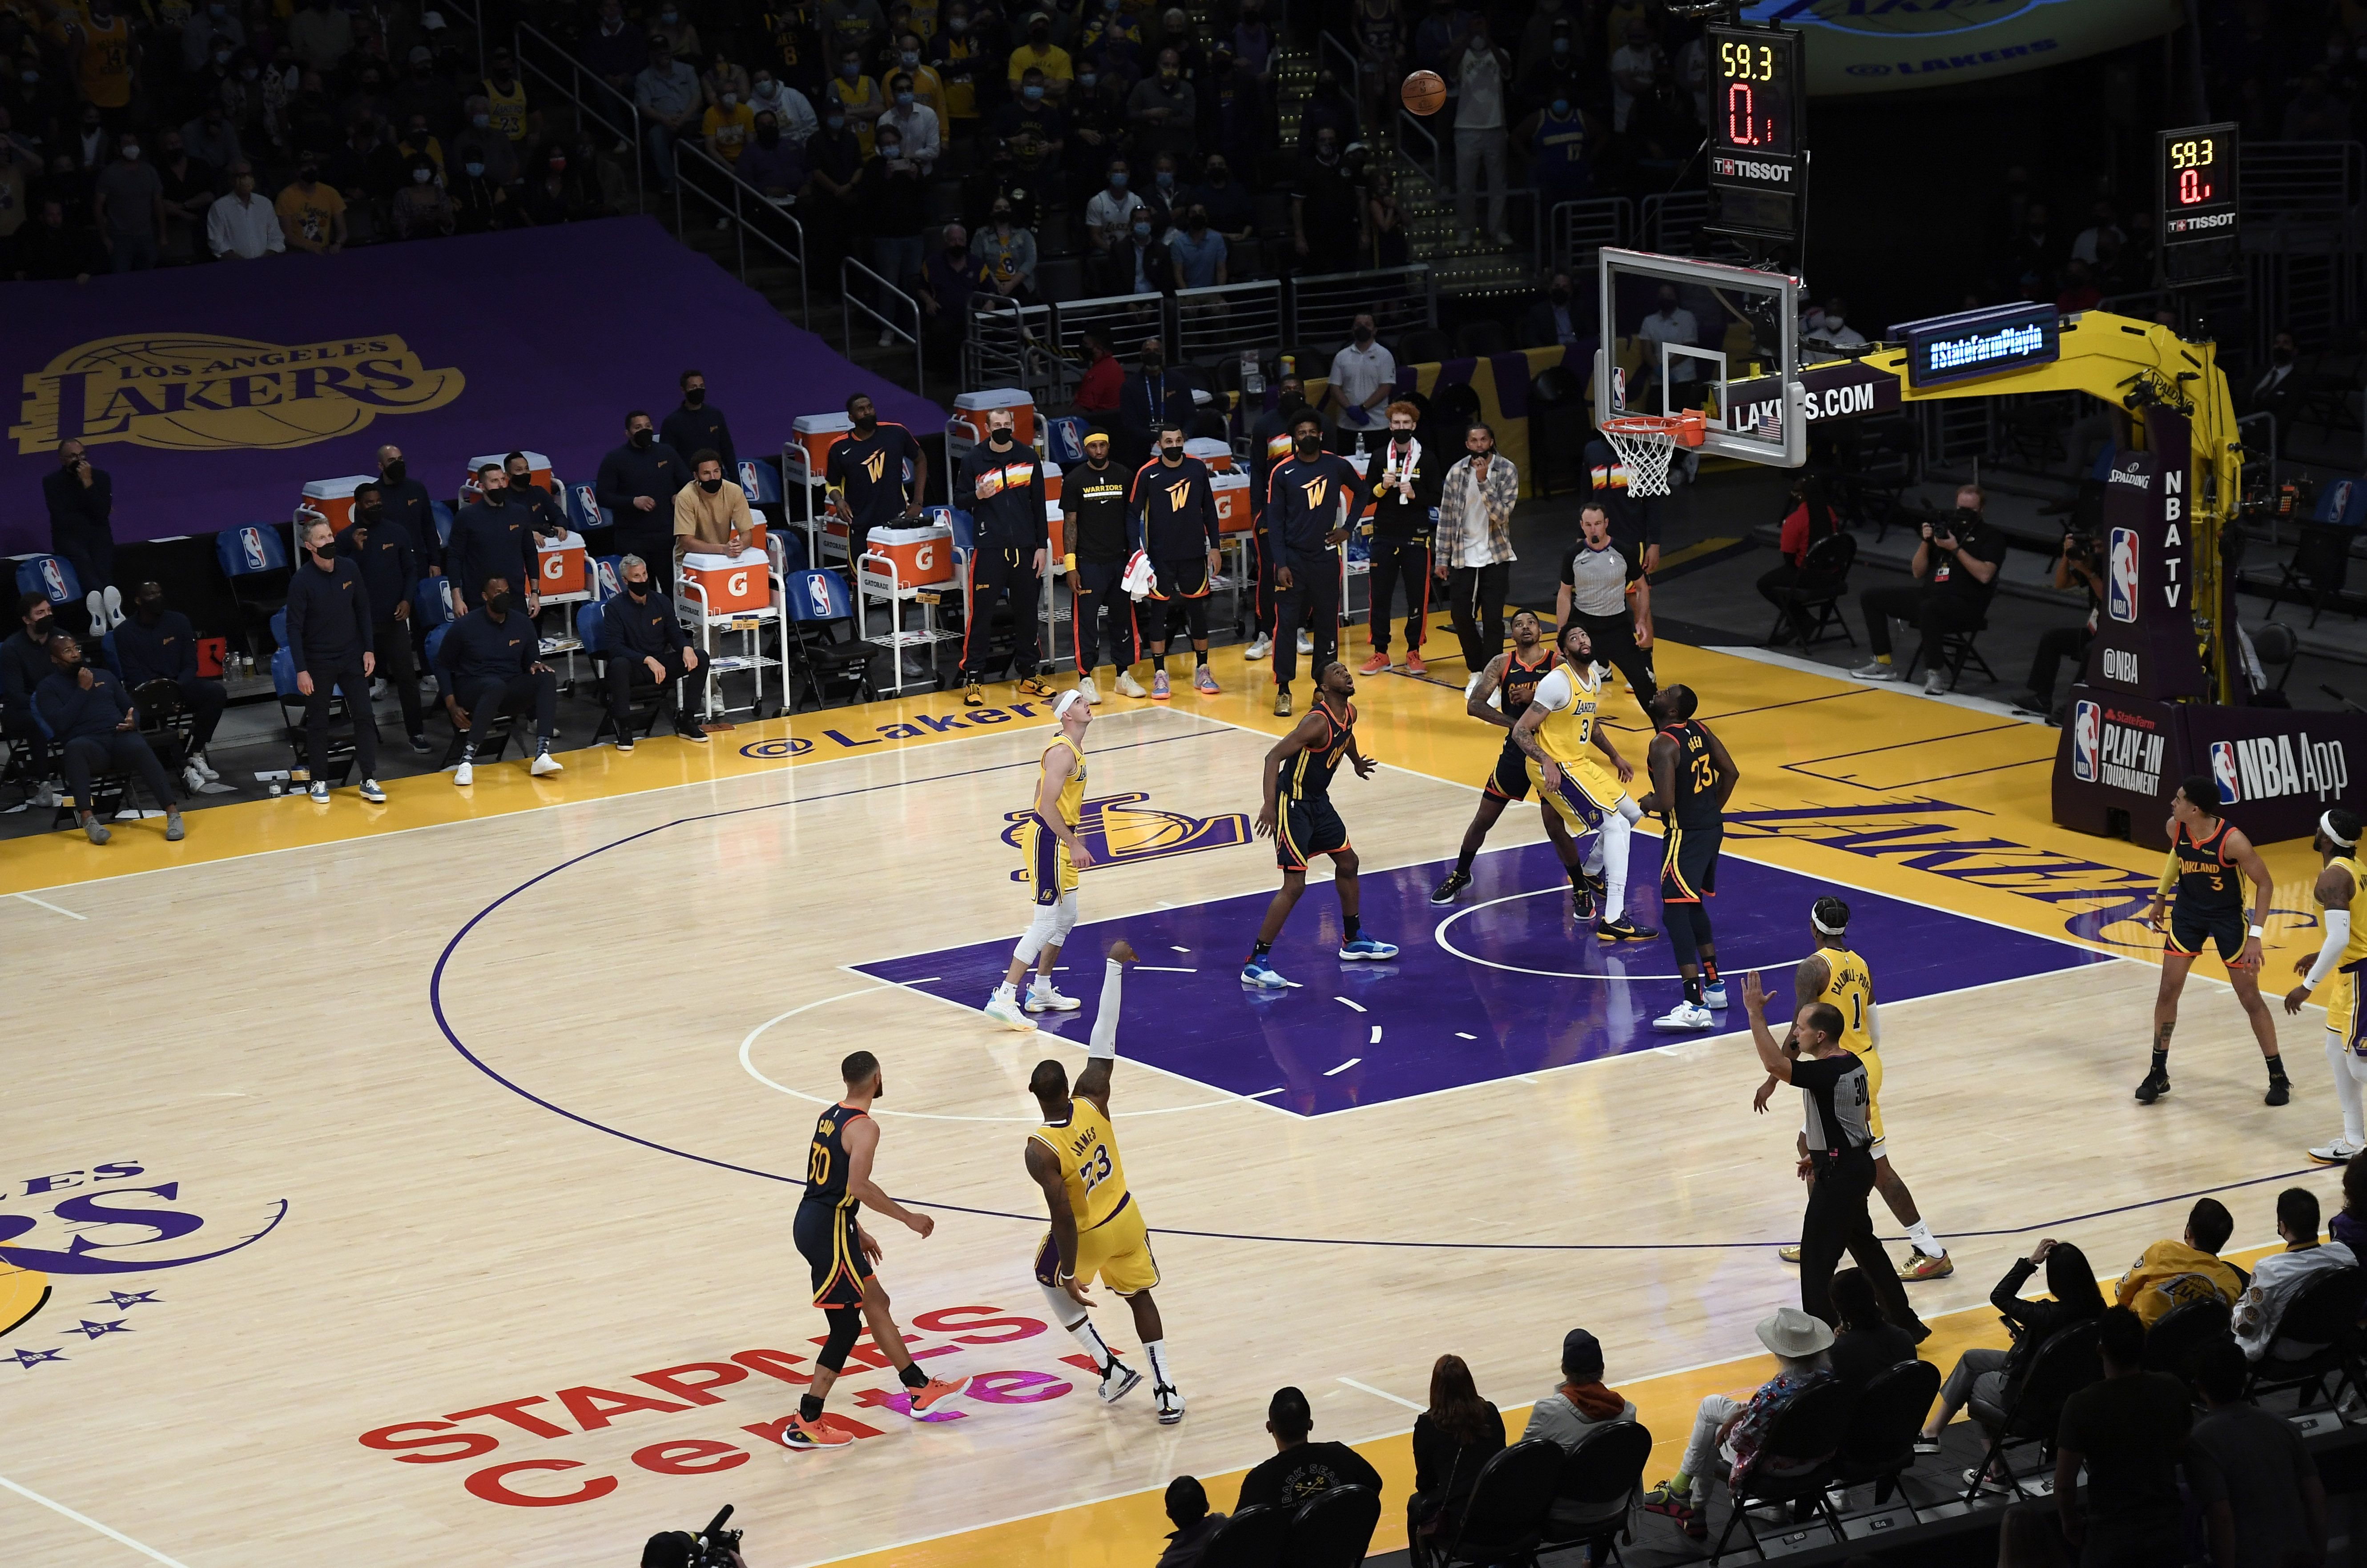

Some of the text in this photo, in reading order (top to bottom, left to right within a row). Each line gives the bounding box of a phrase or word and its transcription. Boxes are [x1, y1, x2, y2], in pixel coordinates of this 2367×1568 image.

[1722, 43, 1771, 80] 59.3
[1730, 83, 1772, 145] 0.1
[2172, 139, 2213, 169] 59.3
[1735, 160, 1792, 181] TISSOT
[2181, 170, 2210, 203] 0.1
[2187, 213, 2236, 230] TISSOT
[120, 341, 389, 380] LOS ANGELES
[1930, 324, 2042, 370] #StateFarmPlayIn
[38, 358, 445, 443] LAKERS
[2151, 372, 2195, 409] SPALDG
[1735, 383, 1874, 432] LAKS.COM
[1082, 484, 1123, 494] WARRIORS
[2108, 469, 2150, 489] SPALDING
[823, 540, 847, 551] GATORADE
[2164, 470, 2182, 608] NBA TV
[543, 555, 563, 579] G
[915, 546, 934, 571] G
[728, 571, 747, 596] G
[864, 579, 889, 591] GATORADE
[679, 604, 699, 616] GATORADE
[2113, 599, 2126, 615] NBA
[2104, 648, 2138, 684] @NBA
[1572, 700, 1596, 715] LAKER
[1579, 719, 1590, 744] 3
[2102, 723, 2165, 774] PLAY-IN
[1691, 753, 1713, 794] 23
[2077, 761, 2089, 776] NBA
[2101, 762, 2160, 797] TOURNAMENT
[2237, 732, 2348, 802] NBA App
[2179, 857, 2220, 875] OAKLAND
[2211, 877, 2223, 891] 3
[1852, 992, 1861, 1032] 1
[1854, 1074, 1867, 1107] 30
[1071, 1126, 1097, 1157] JAMES
[809, 1140, 831, 1186] 30
[1079, 1143, 1114, 1198] 23
[111, 1295, 142, 1304] '85
[81, 1323, 109, 1333] '87
[16, 1353, 47, 1362] '88
[358, 1306, 1048, 1464] STAPLES
[1282, 1464, 1340, 1504] DARK SEAS
[1794, 1532, 1805, 1540] 65
